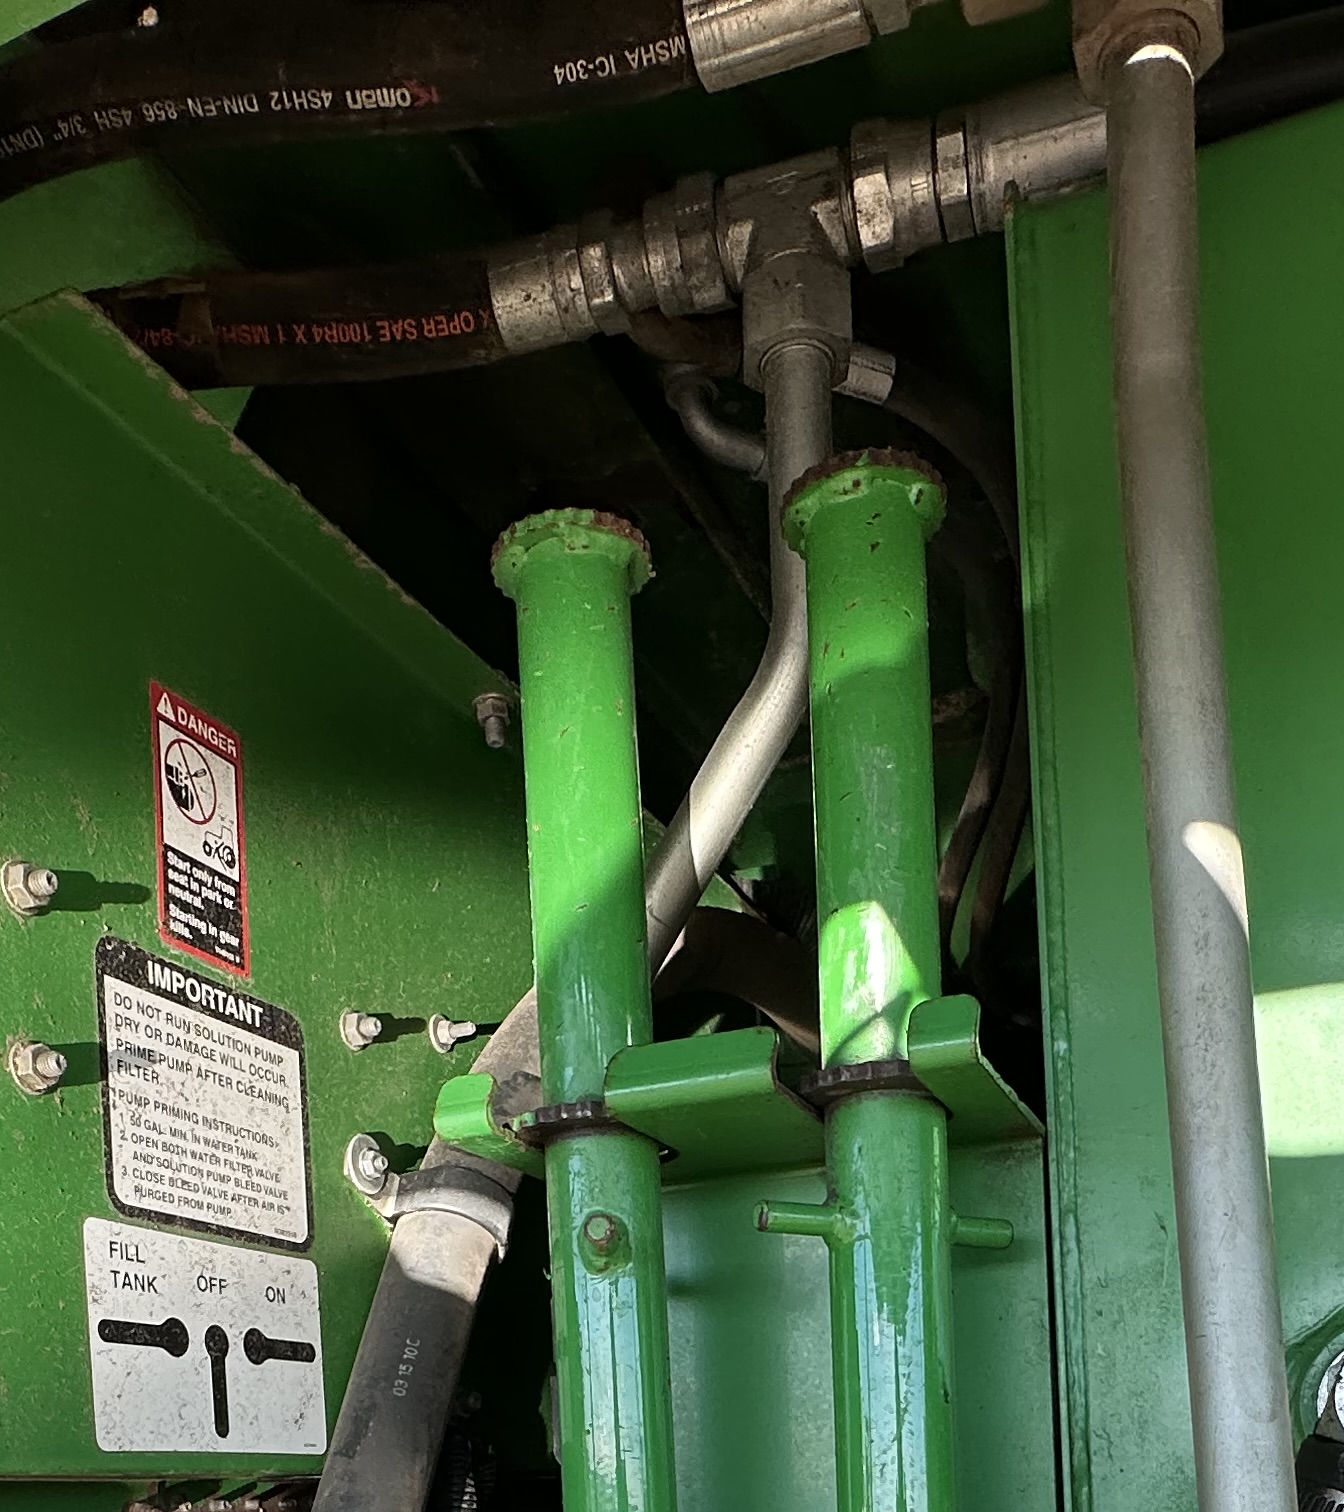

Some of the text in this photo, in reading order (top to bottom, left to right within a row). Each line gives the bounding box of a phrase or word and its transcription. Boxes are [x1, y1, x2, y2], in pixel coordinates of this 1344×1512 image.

[554, 33, 686, 86] MSHA IC-304
[93, 104, 133, 129] 4SH
[269, 87, 333, 112] 4SH12
[213, 323, 270, 346] MSH
[293, 322, 307, 344] X
[312, 321, 371, 345] 100R4
[376, 318, 419, 343] SAE
[422, 310, 475, 337] OPER
[176, 706, 238, 759] DANGER
[167, 850, 236, 897] Start only from
[167, 869, 189, 888] seat
[190, 876, 200, 892] in
[202, 884, 222, 904] park
[169, 904, 240, 947] Starting in gear
[147, 960, 264, 1028] IMPORTANT
[114, 991, 284, 1067] DO NOT RUN SOLUTION PUMP
[115, 1013, 140, 1033] DRY
[145, 1024, 162, 1042] OR
[166, 1033, 217, 1062] DAMAGE
[219, 1052, 246, 1074] WILL
[116, 1038, 290, 1110] PRIME PUMP AFTER CLEANING
[118, 1089, 150, 1109] PUMP
[154, 1101, 199, 1125] PRIMING
[131, 1132, 159, 1148] OPEN
[161, 1140, 188, 1158] BOTH
[190, 1148, 221, 1167] WATER
[224, 1158, 253, 1176] FILTER
[254, 1167, 281, 1183] VALVE
[191, 1130, 201, 1144] IN
[202, 1136, 234, 1154] WATER
[132, 1167, 166, 1185] CLOSE
[169, 1176, 200, 1194] BLEED
[202, 1183, 229, 1201] VALVE
[231, 1193, 259, 1209] AFTER
[261, 1200, 275, 1212] AIR
[133, 1151, 289, 1201] AND SOLUTION PUMP BLEED VALVE
[134, 1184, 175, 1204] PURGED
[178, 1196, 205, 1211] FROM
[109, 1240, 146, 1264] FILL
[110, 1270, 286, 1304] TANK OFF ON
[398, 1364, 413, 1375] 15
[393, 1379, 408, 1397] 03
